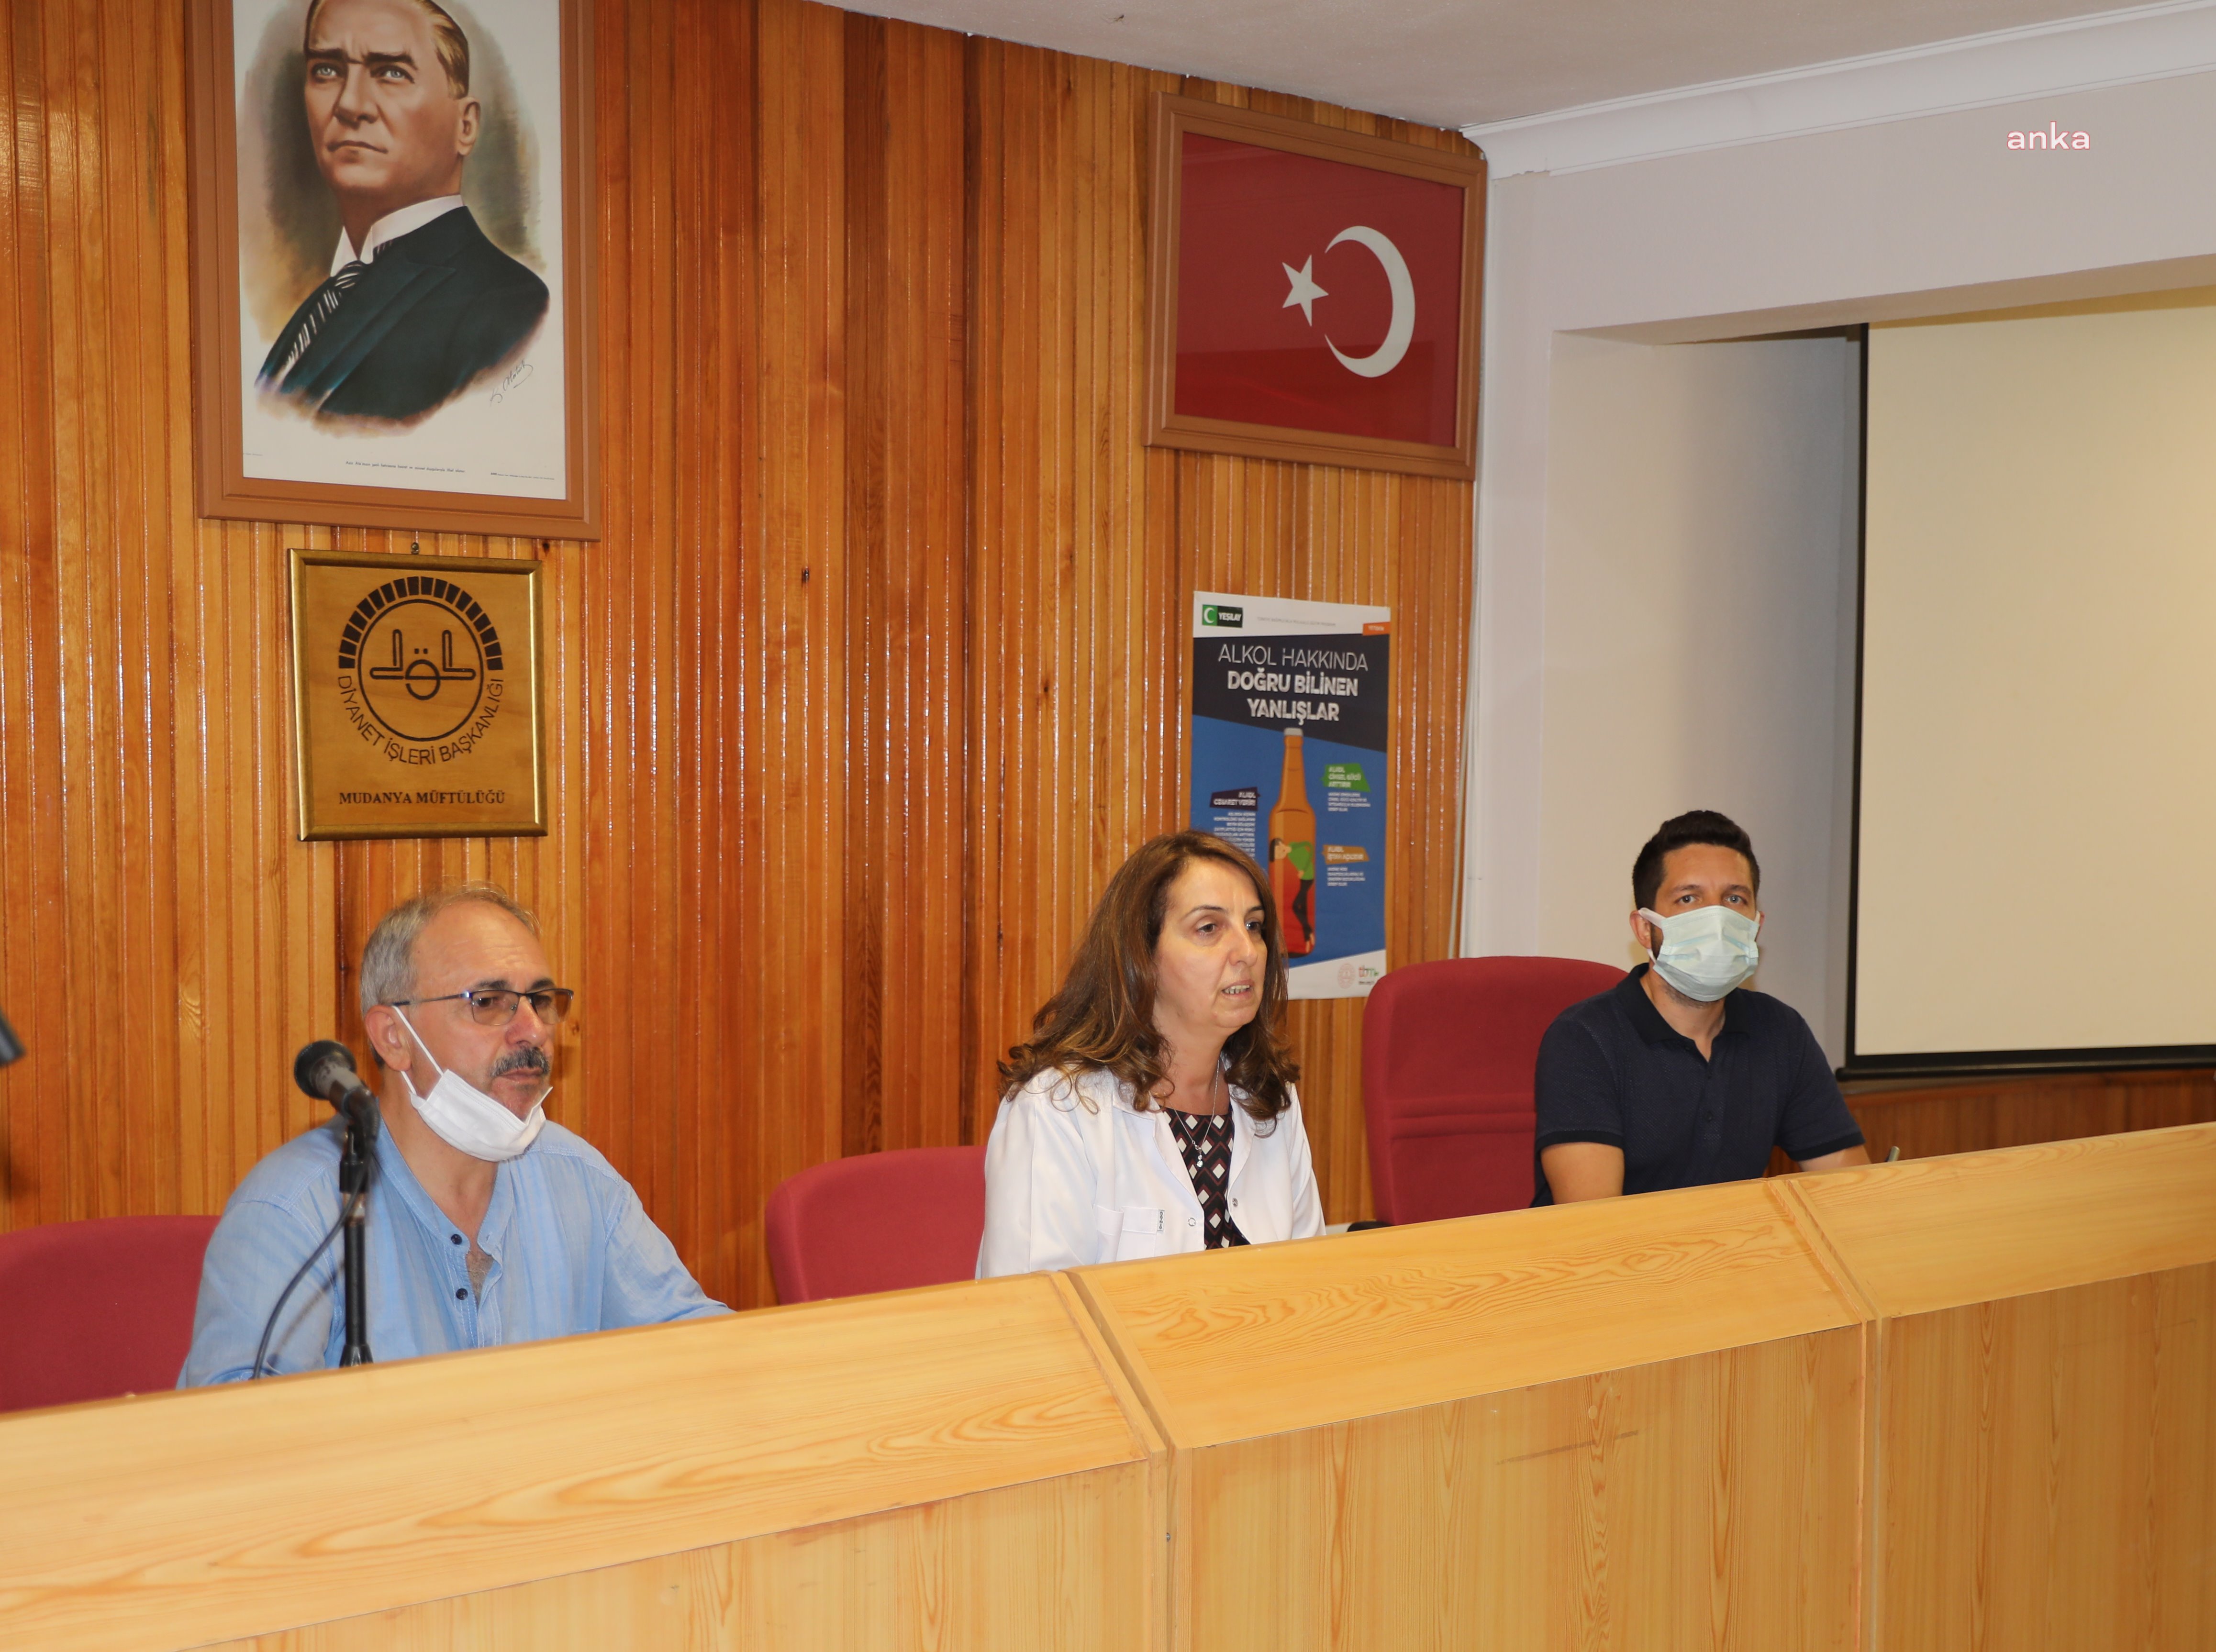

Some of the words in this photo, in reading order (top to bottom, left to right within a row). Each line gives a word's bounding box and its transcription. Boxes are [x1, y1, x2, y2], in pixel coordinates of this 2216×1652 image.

[1218, 643, 1277, 666] ALKOL
[1281, 647, 1369, 672] HAKKINDA
[1227, 667, 1291, 693] DOĞRU
[1294, 671, 1358, 697] BİLİNEN
[337, 676, 385, 746] DİYANET
[384, 737, 435, 765] İŞLERİ
[440, 678, 504, 763] BAŞKANLIĞI
[1247, 698, 1340, 726] YANLIŞLAR
[339, 792, 412, 805] MUDANYA
[416, 789, 505, 804] MÜFTÜLÜĞÜ
